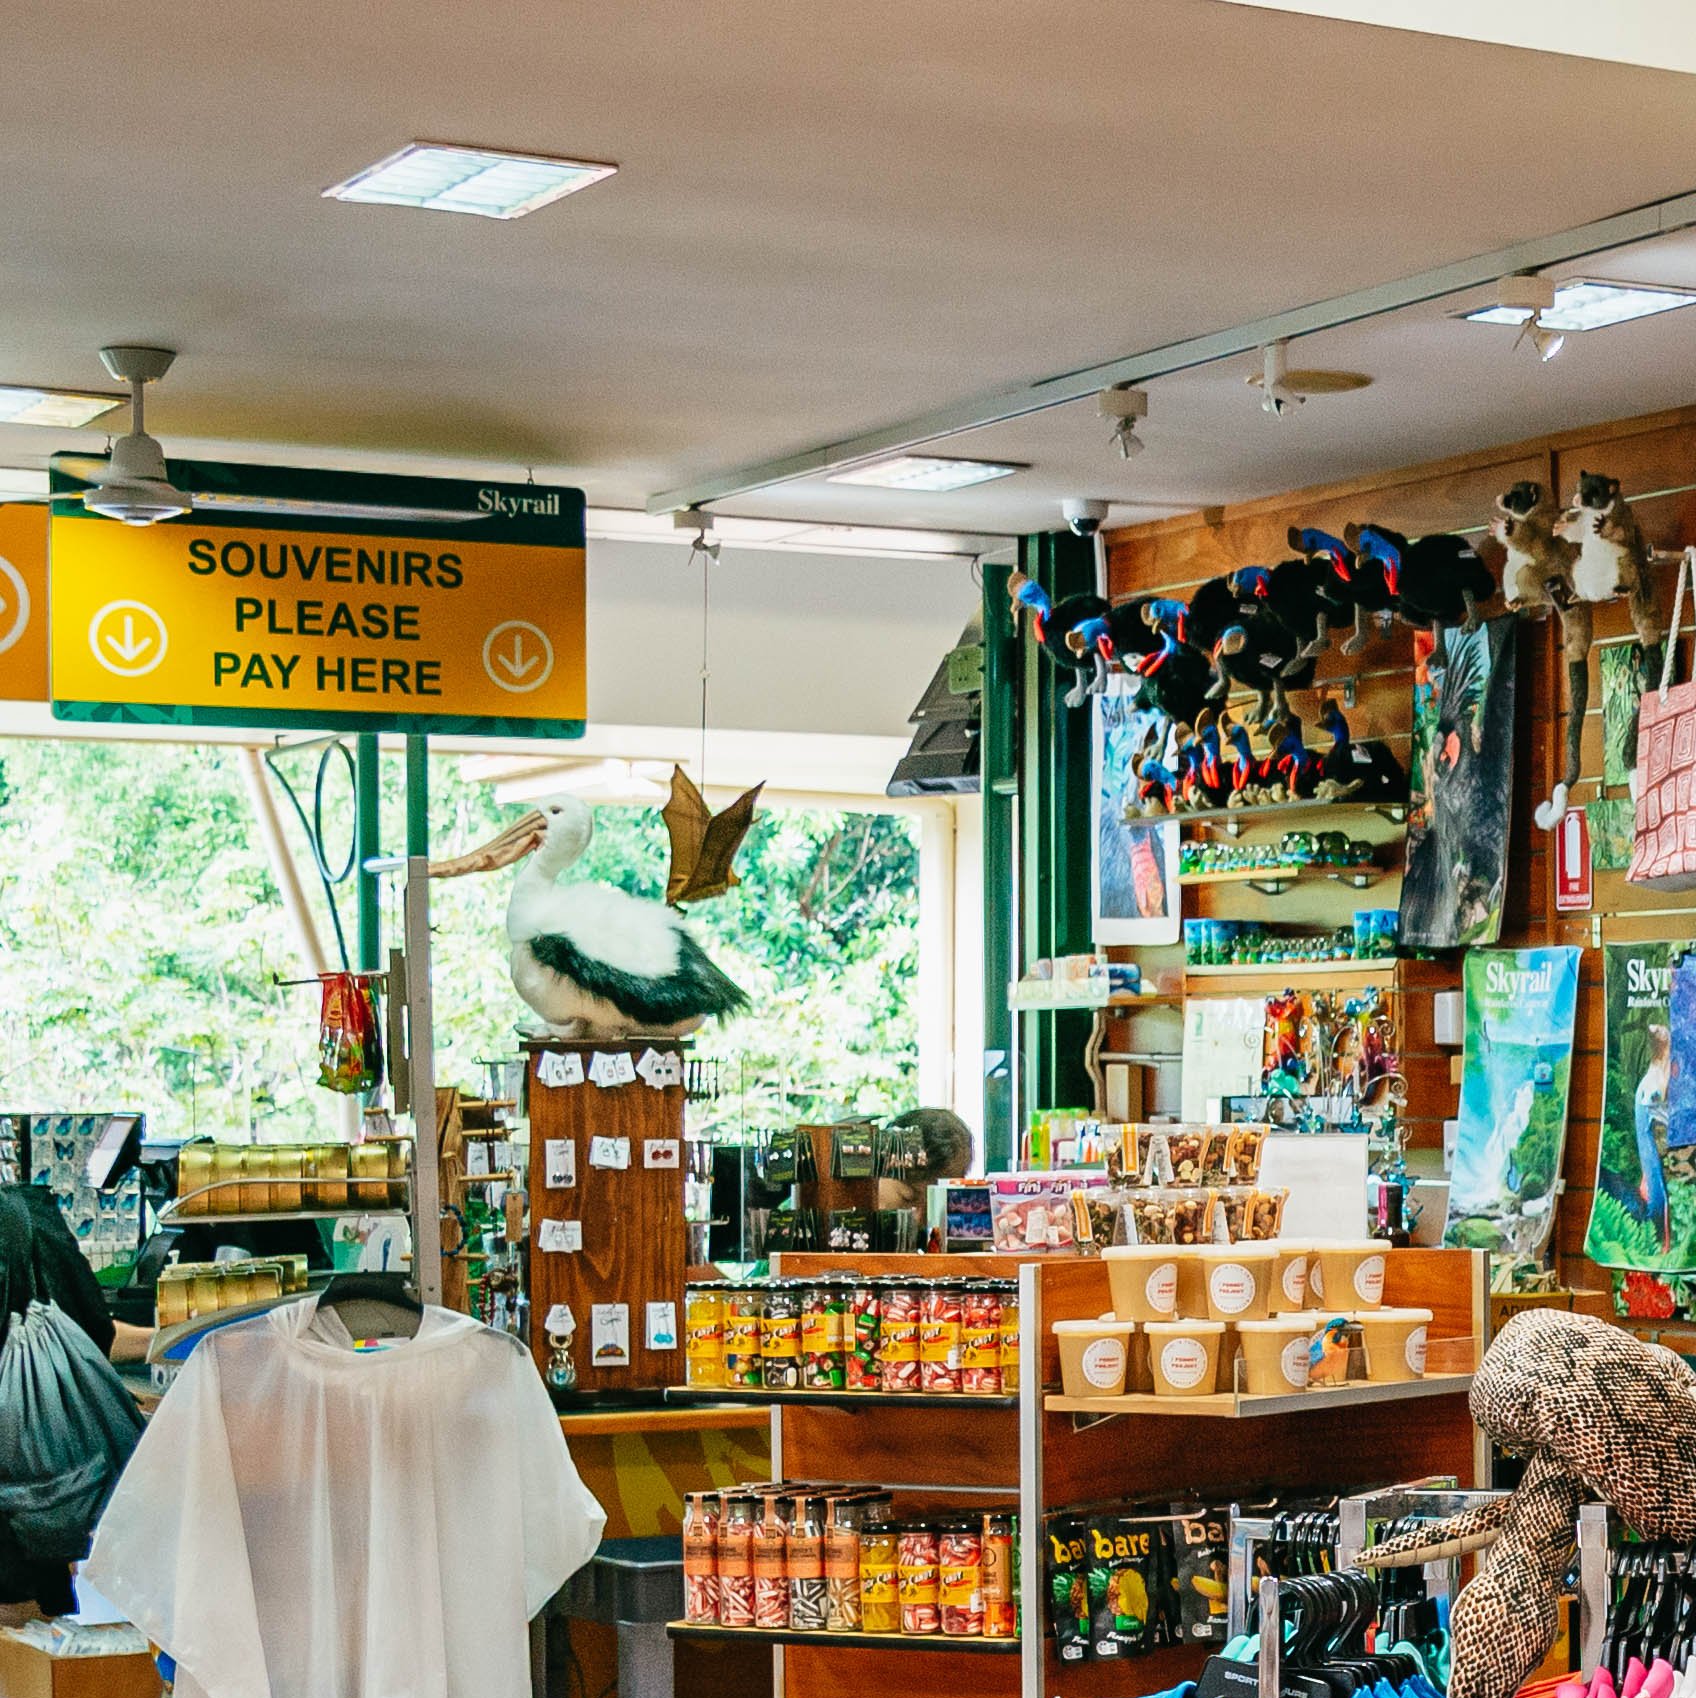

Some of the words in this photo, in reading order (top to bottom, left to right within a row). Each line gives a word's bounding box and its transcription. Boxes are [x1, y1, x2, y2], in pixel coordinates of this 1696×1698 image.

[477, 489, 561, 520] Skyrail
[188, 538, 463, 589] SOUVENIRS
[235, 597, 421, 641] PLEASE
[213, 653, 301, 689] PAY
[316, 656, 442, 696] HERE
[1486, 961, 1553, 1000] Skyrail
[1627, 958, 1672, 999] Skyr
[1018, 1180, 1041, 1194] Fini
[1091, 1529, 1150, 1559] bare
